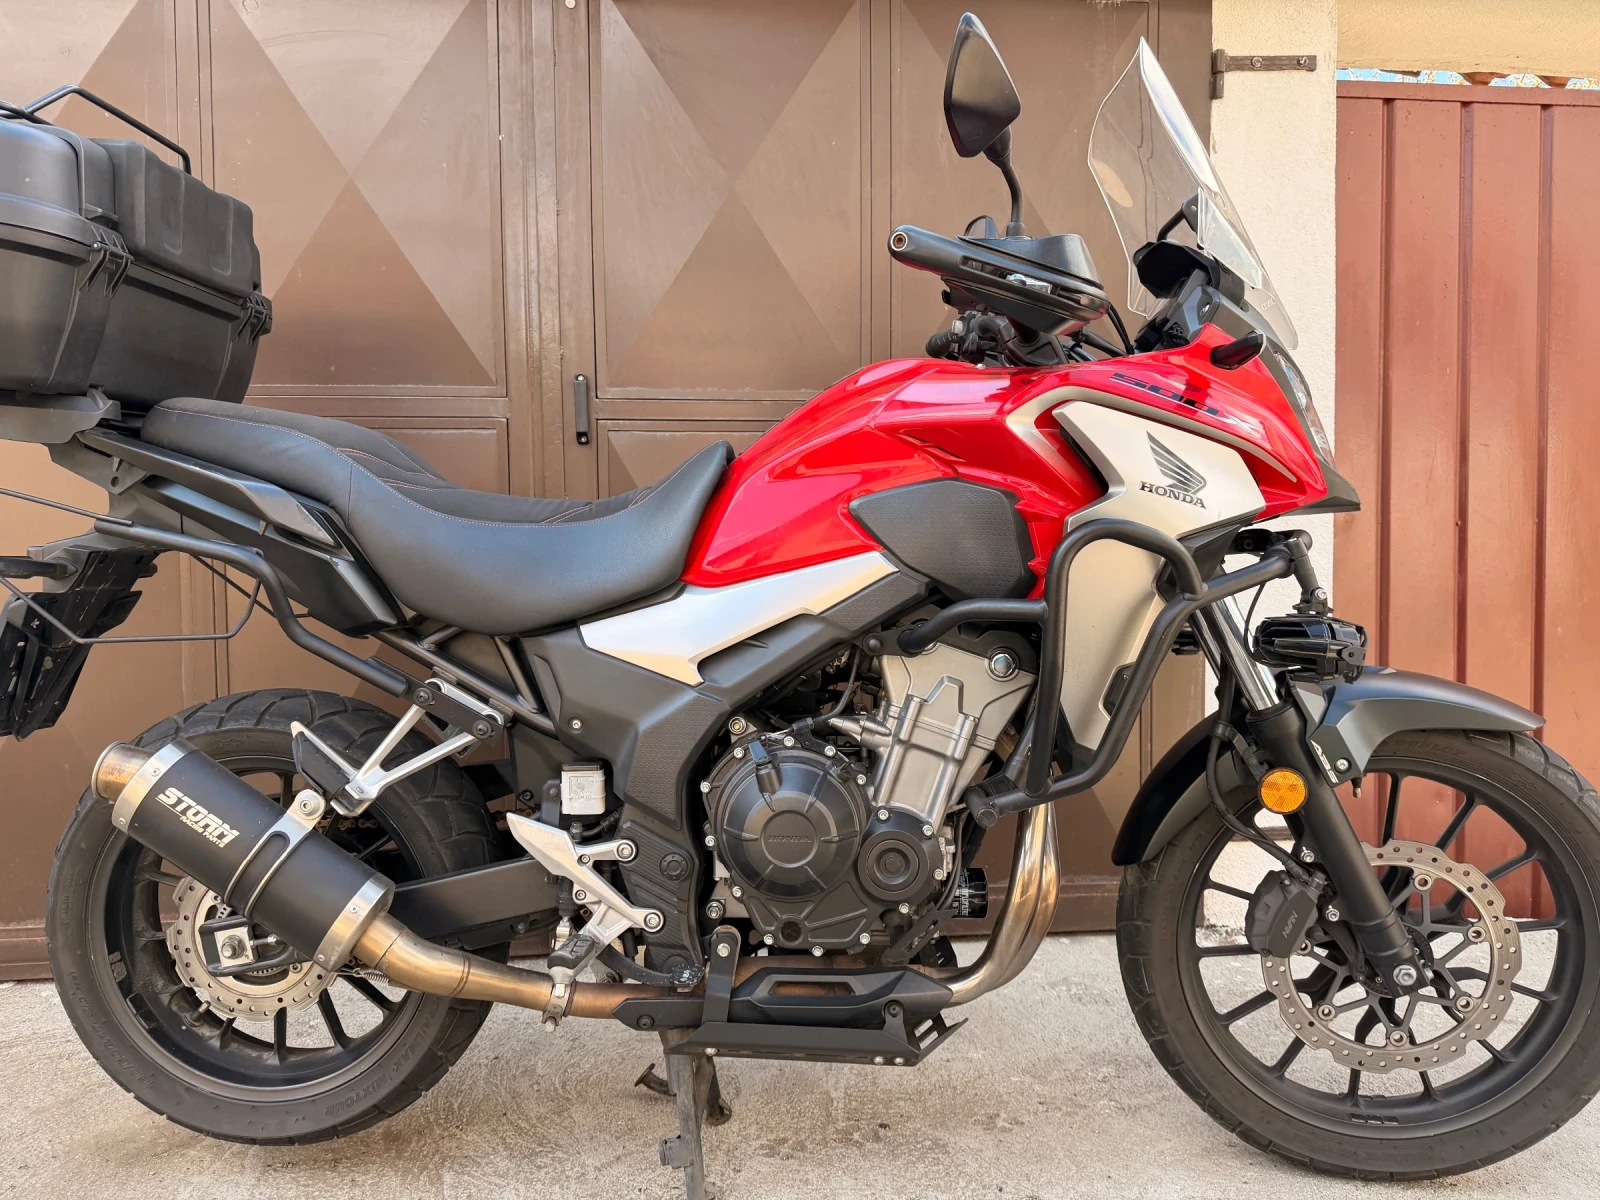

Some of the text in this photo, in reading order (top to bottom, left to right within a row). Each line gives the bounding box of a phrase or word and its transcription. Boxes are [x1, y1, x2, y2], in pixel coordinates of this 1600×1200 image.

[1138, 480, 1207, 509] HONDA
[1310, 739, 1339, 784] ABS
[156, 787, 240, 845] STORM
[202, 829, 226, 848] PARTS
[767, 834, 812, 843] HONDA
[324, 1073, 389, 1117] MIXTOUR
